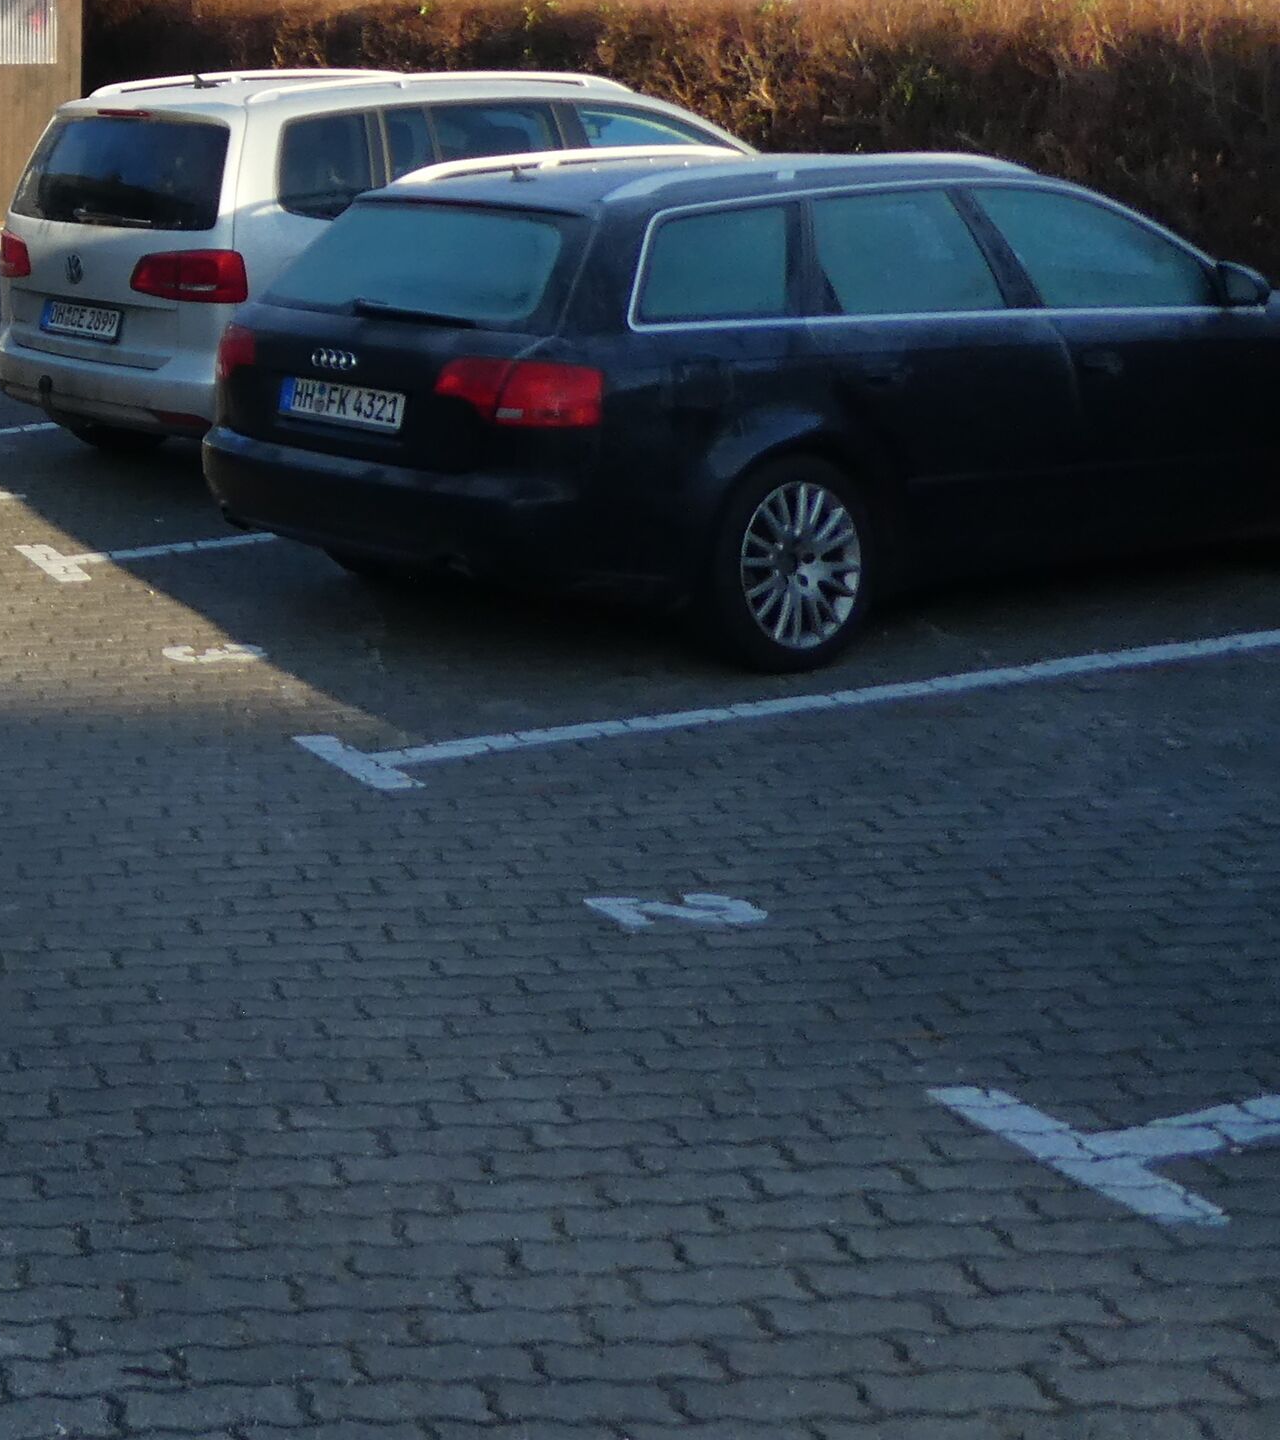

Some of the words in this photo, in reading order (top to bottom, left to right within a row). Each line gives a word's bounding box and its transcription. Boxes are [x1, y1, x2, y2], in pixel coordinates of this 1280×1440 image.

[70, 307, 87, 328] CE
[86, 311, 117, 333] 2899
[293, 382, 316, 410] HH
[326, 386, 351, 416] FK
[353, 390, 398, 424] 4321
